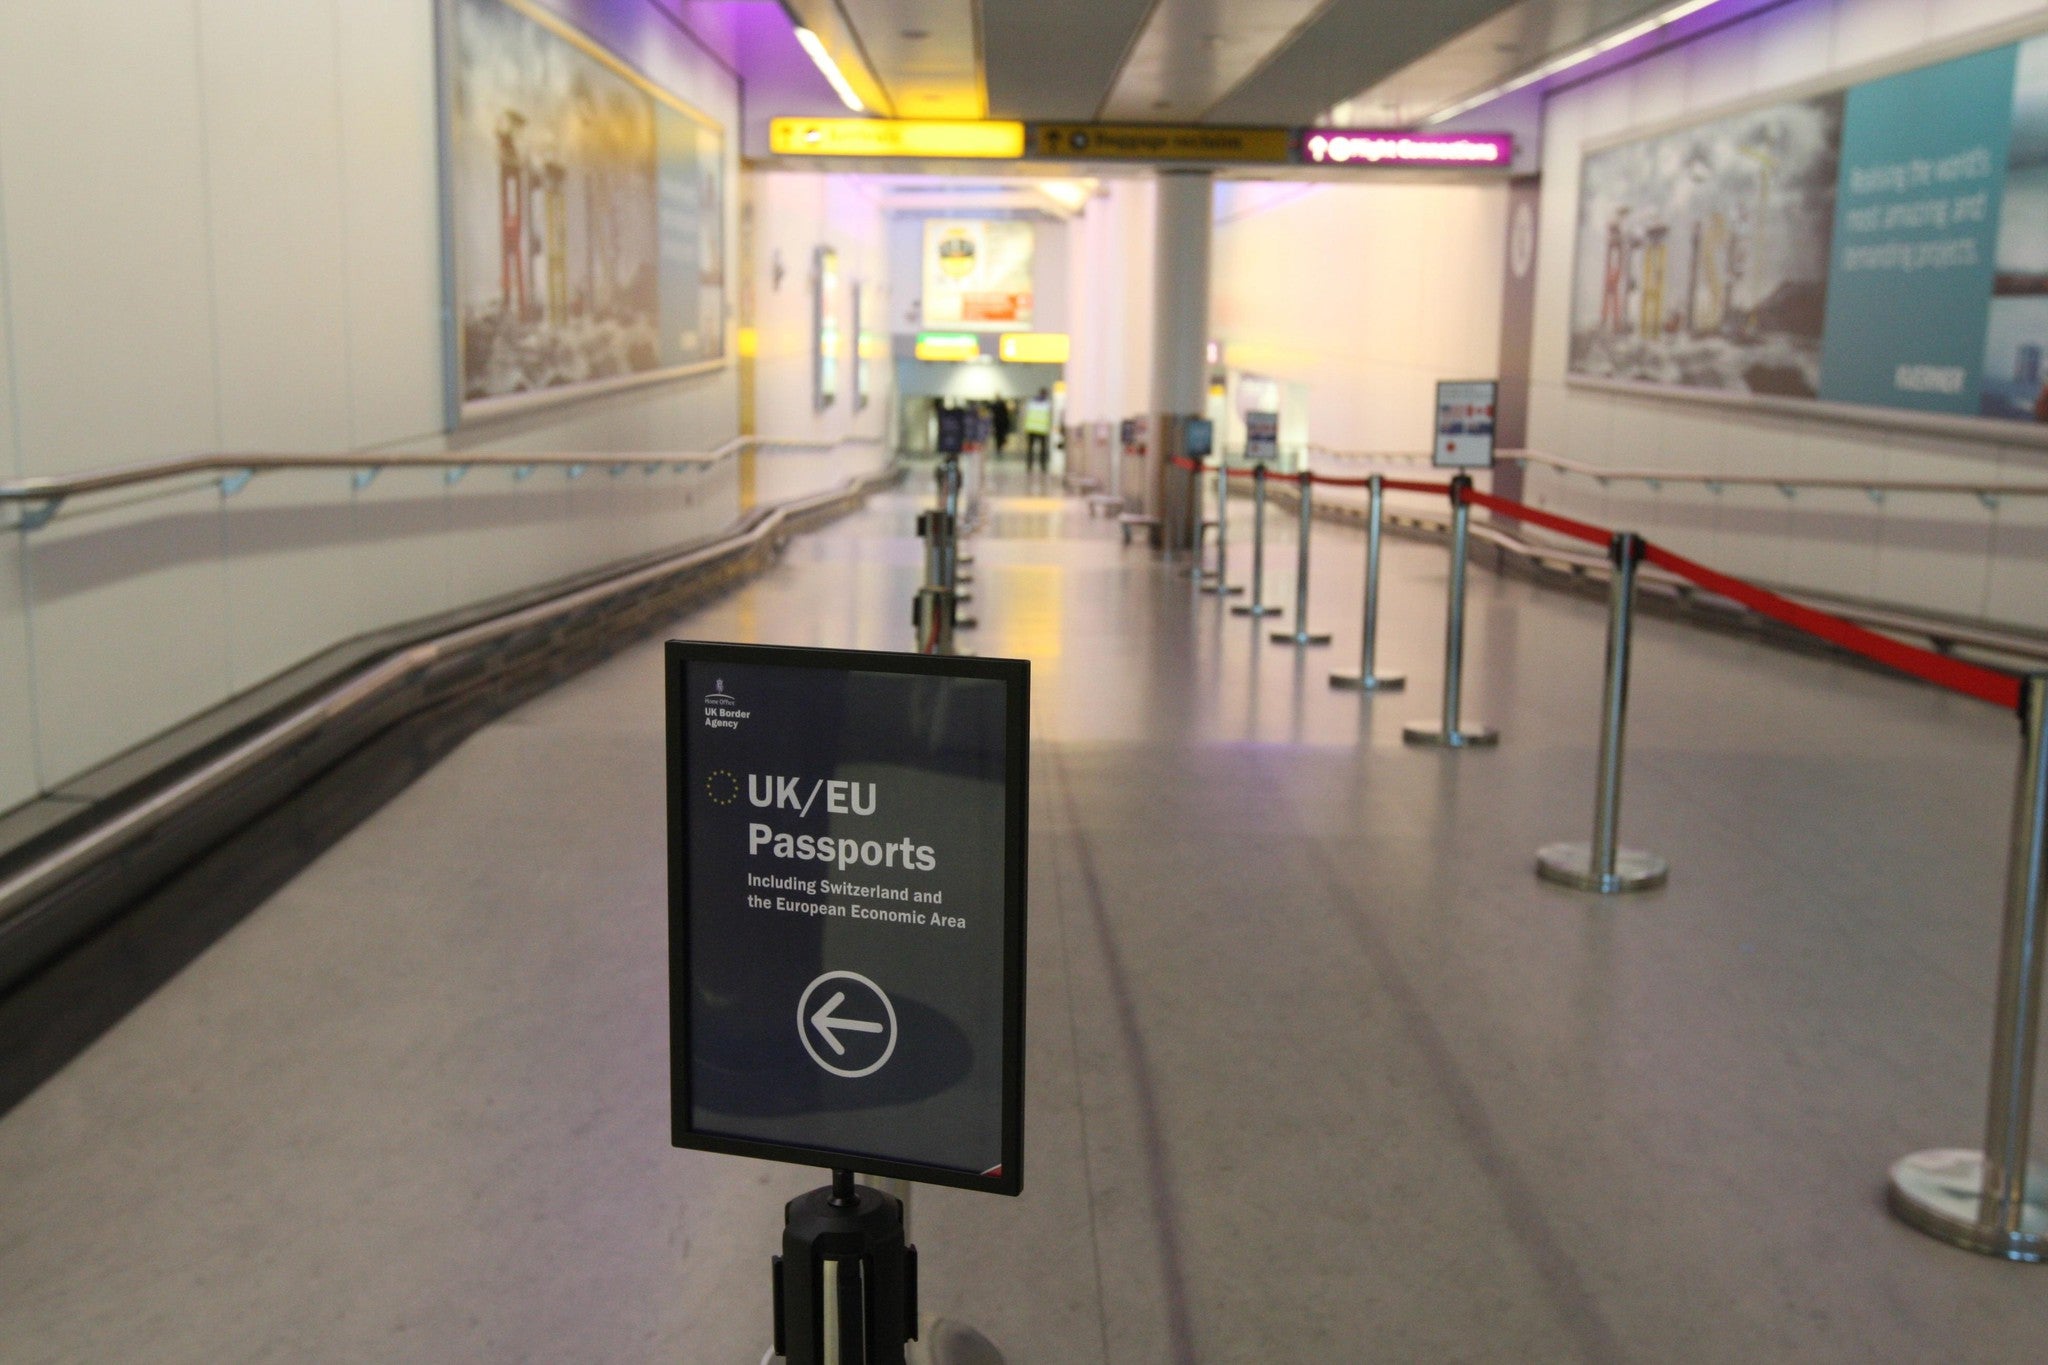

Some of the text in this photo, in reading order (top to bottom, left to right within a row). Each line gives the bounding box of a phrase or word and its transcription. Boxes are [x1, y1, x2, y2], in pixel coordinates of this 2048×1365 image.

[705, 707, 750, 718] UK Border
[705, 718, 738, 729] Agency
[748, 774, 877, 817] UK/EU
[749, 822, 936, 871] Passports
[748, 873, 943, 905] Including Switzerland and
[747, 894, 967, 930] the European Economic Area
